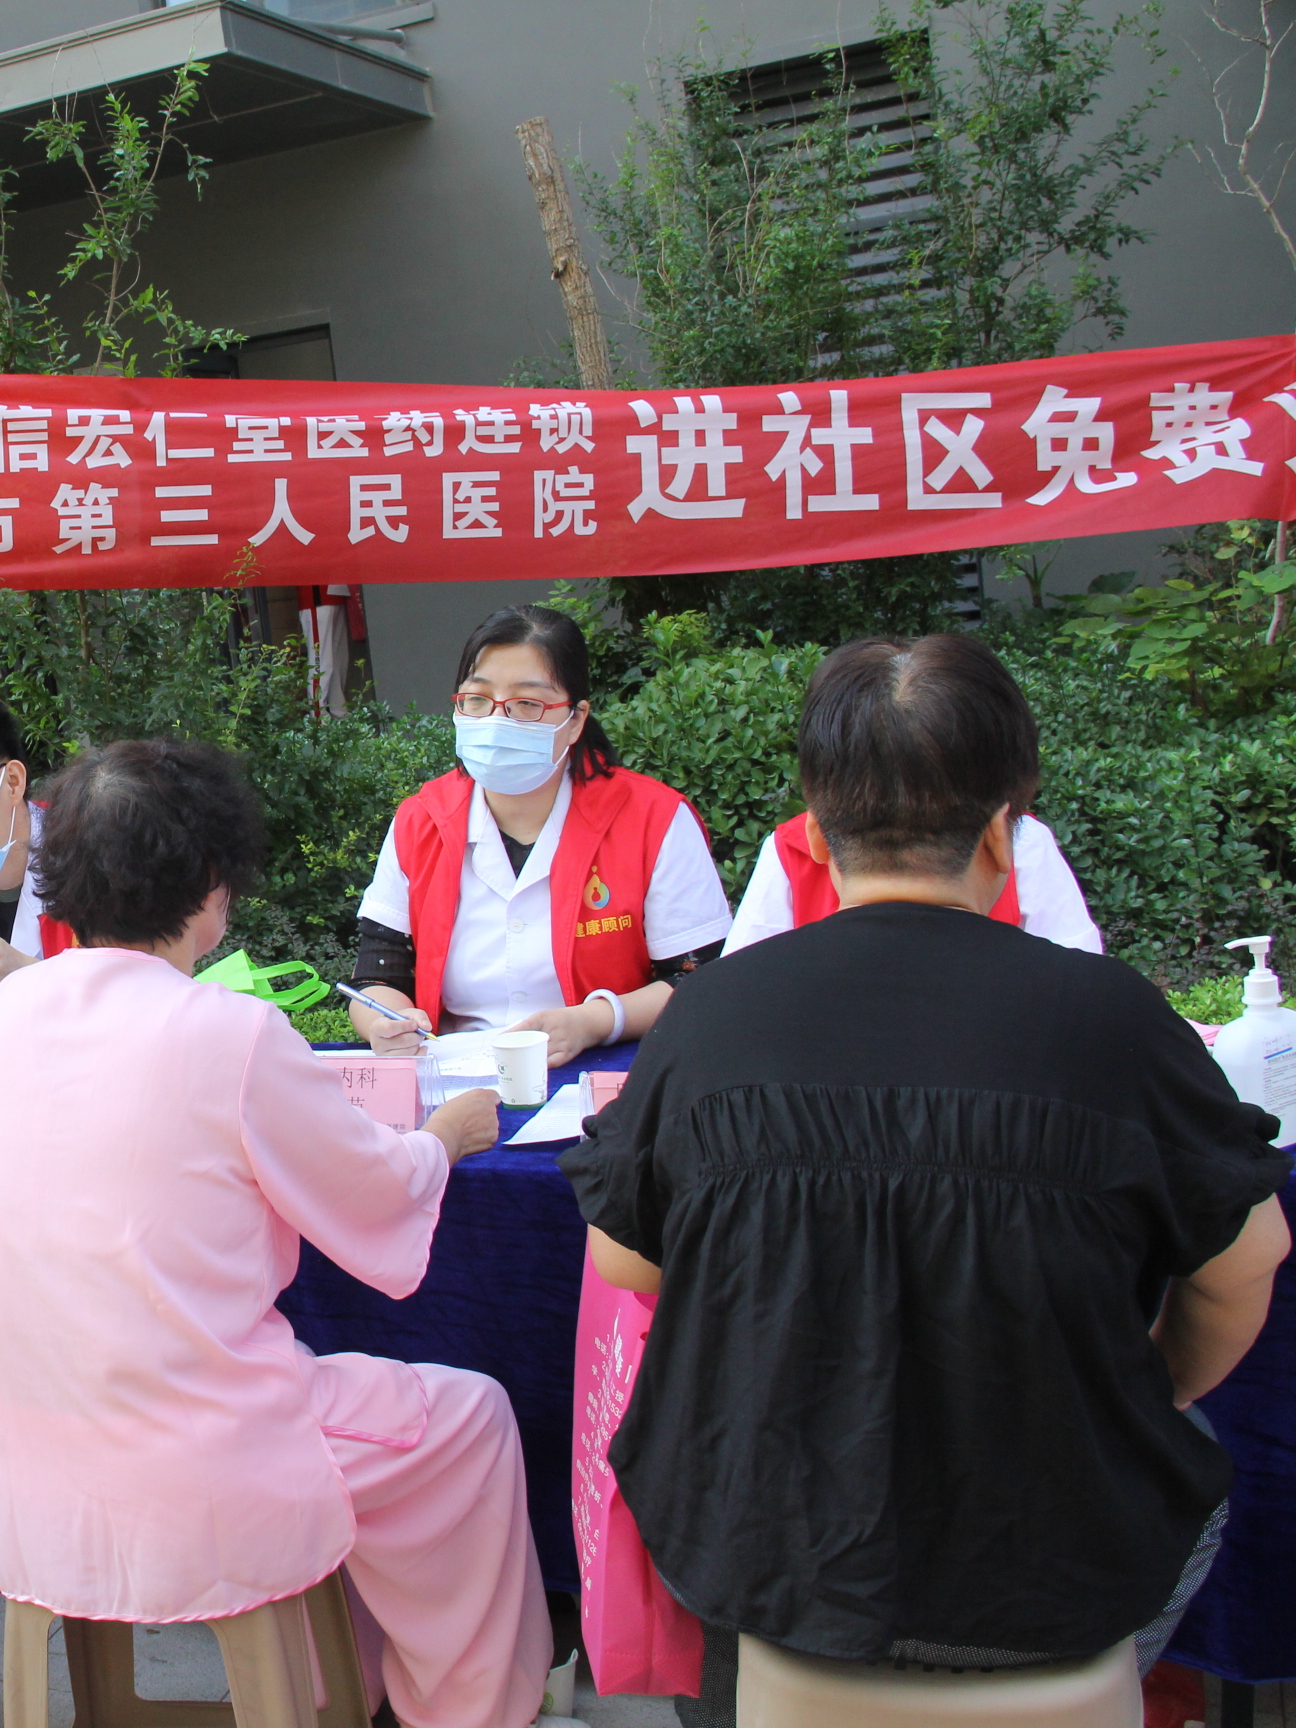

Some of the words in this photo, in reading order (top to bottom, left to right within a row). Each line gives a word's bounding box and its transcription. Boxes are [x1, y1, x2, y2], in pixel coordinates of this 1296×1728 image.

[626, 381, 1296, 523] 进社区免费
